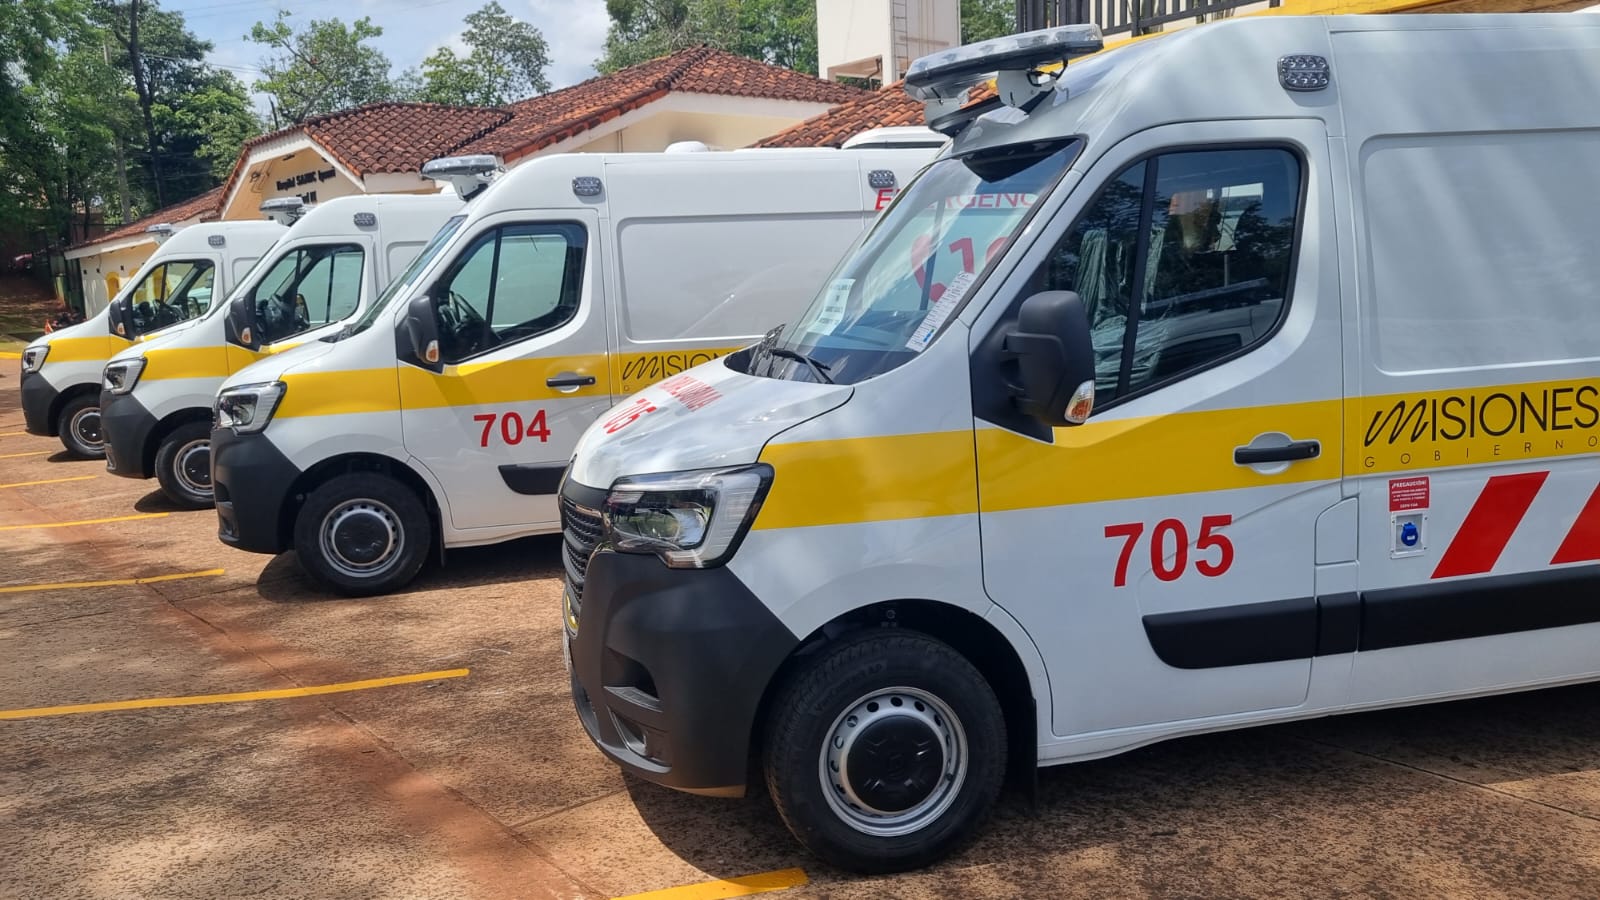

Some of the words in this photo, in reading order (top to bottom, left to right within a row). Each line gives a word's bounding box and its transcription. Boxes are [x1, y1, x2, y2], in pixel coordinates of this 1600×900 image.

[473, 408, 552, 448] 704
[1364, 385, 1600, 447] MISIONES
[1364, 435, 1599, 468] GOBIERNO
[1103, 513, 1235, 588] 705
